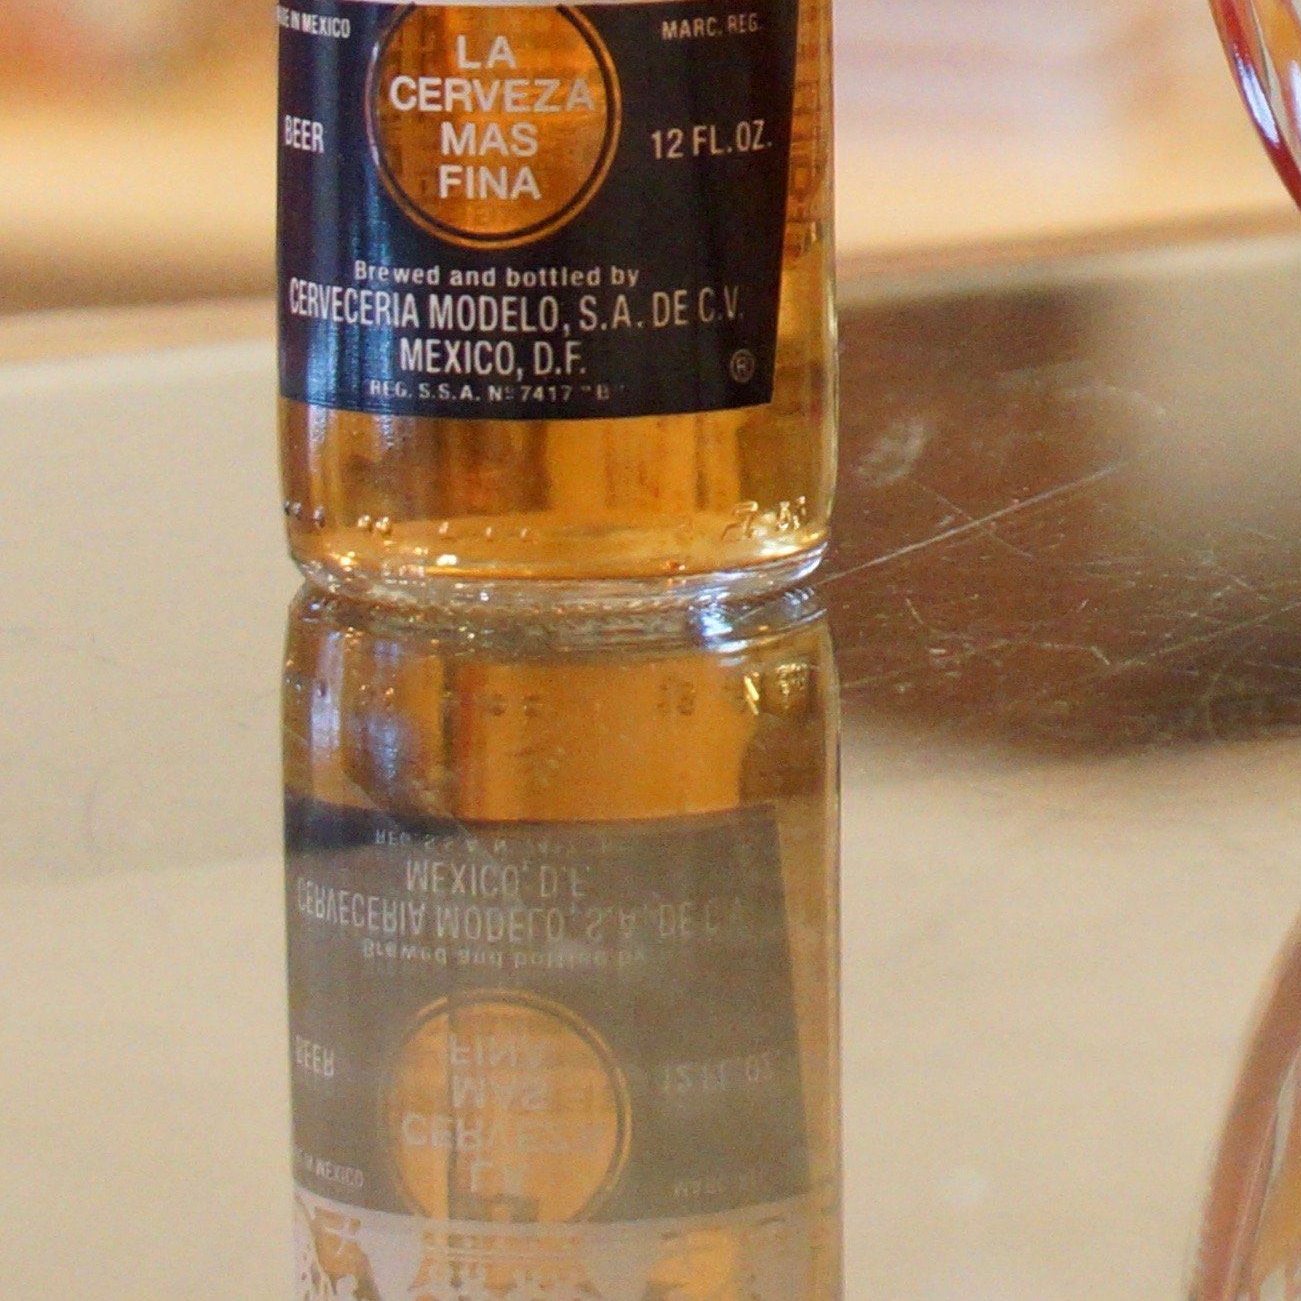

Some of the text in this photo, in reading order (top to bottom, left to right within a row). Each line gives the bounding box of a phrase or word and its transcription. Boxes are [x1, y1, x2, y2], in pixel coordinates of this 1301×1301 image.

[302, 12, 351, 39] MEXICO
[661, 15, 723, 40] MARC.
[456, 34, 517, 70] LA
[389, 75, 596, 114] CERVEZA
[285, 115, 324, 154] BEER
[441, 121, 539, 158] MAS
[651, 128, 685, 160] 12
[439, 164, 542, 200] FINA
[354, 260, 639, 287] Brewed and bottled by
[289, 276, 420, 329] CERVECERIA
[428, 293, 570, 337] MODELO,
[579, 293, 644, 332] S.A.
[652, 289, 688, 328] DE
[400, 337, 586, 382] MEXICO, D.F.
